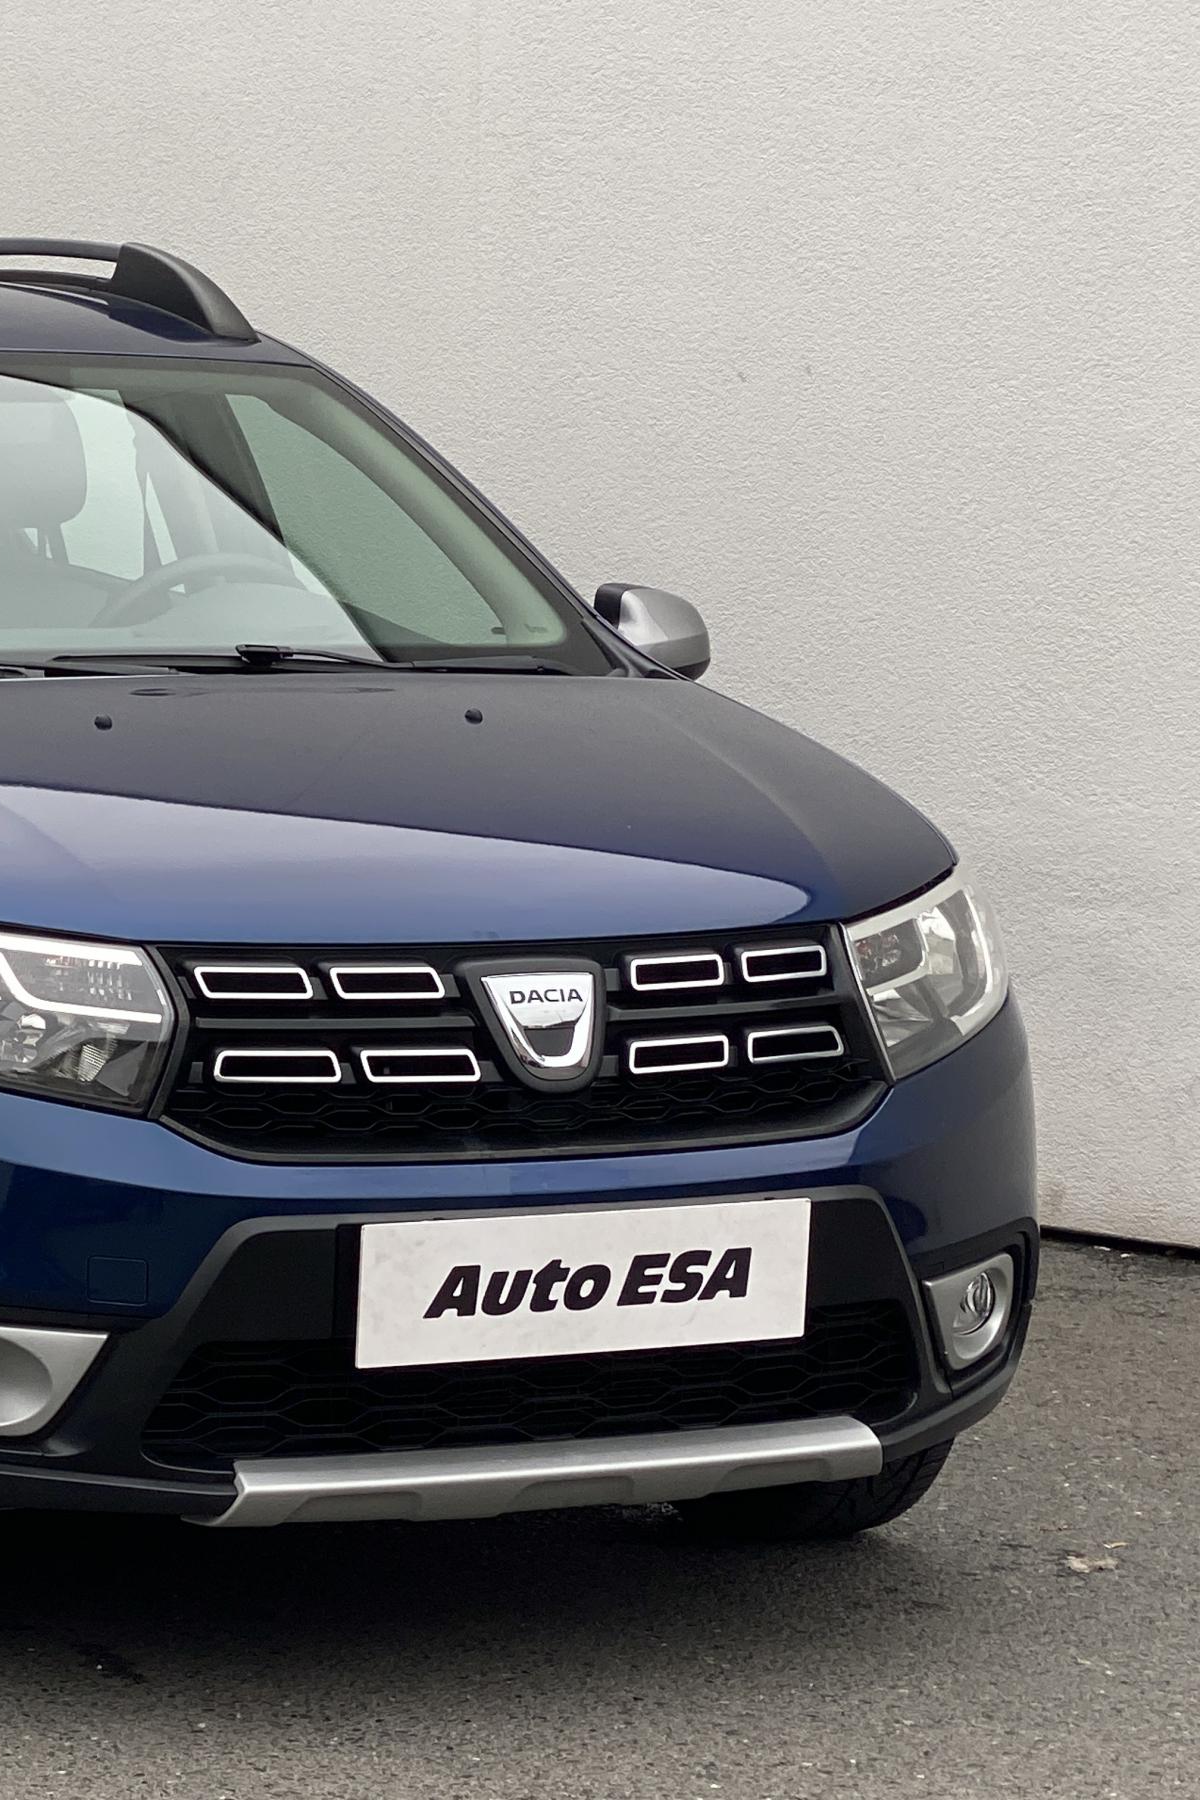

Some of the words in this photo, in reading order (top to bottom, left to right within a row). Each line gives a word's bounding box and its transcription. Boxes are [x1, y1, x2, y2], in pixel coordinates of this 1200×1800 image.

[509, 988, 584, 1005] DACIA
[423, 1259, 612, 1319] Auto
[617, 1247, 752, 1308] ESA
